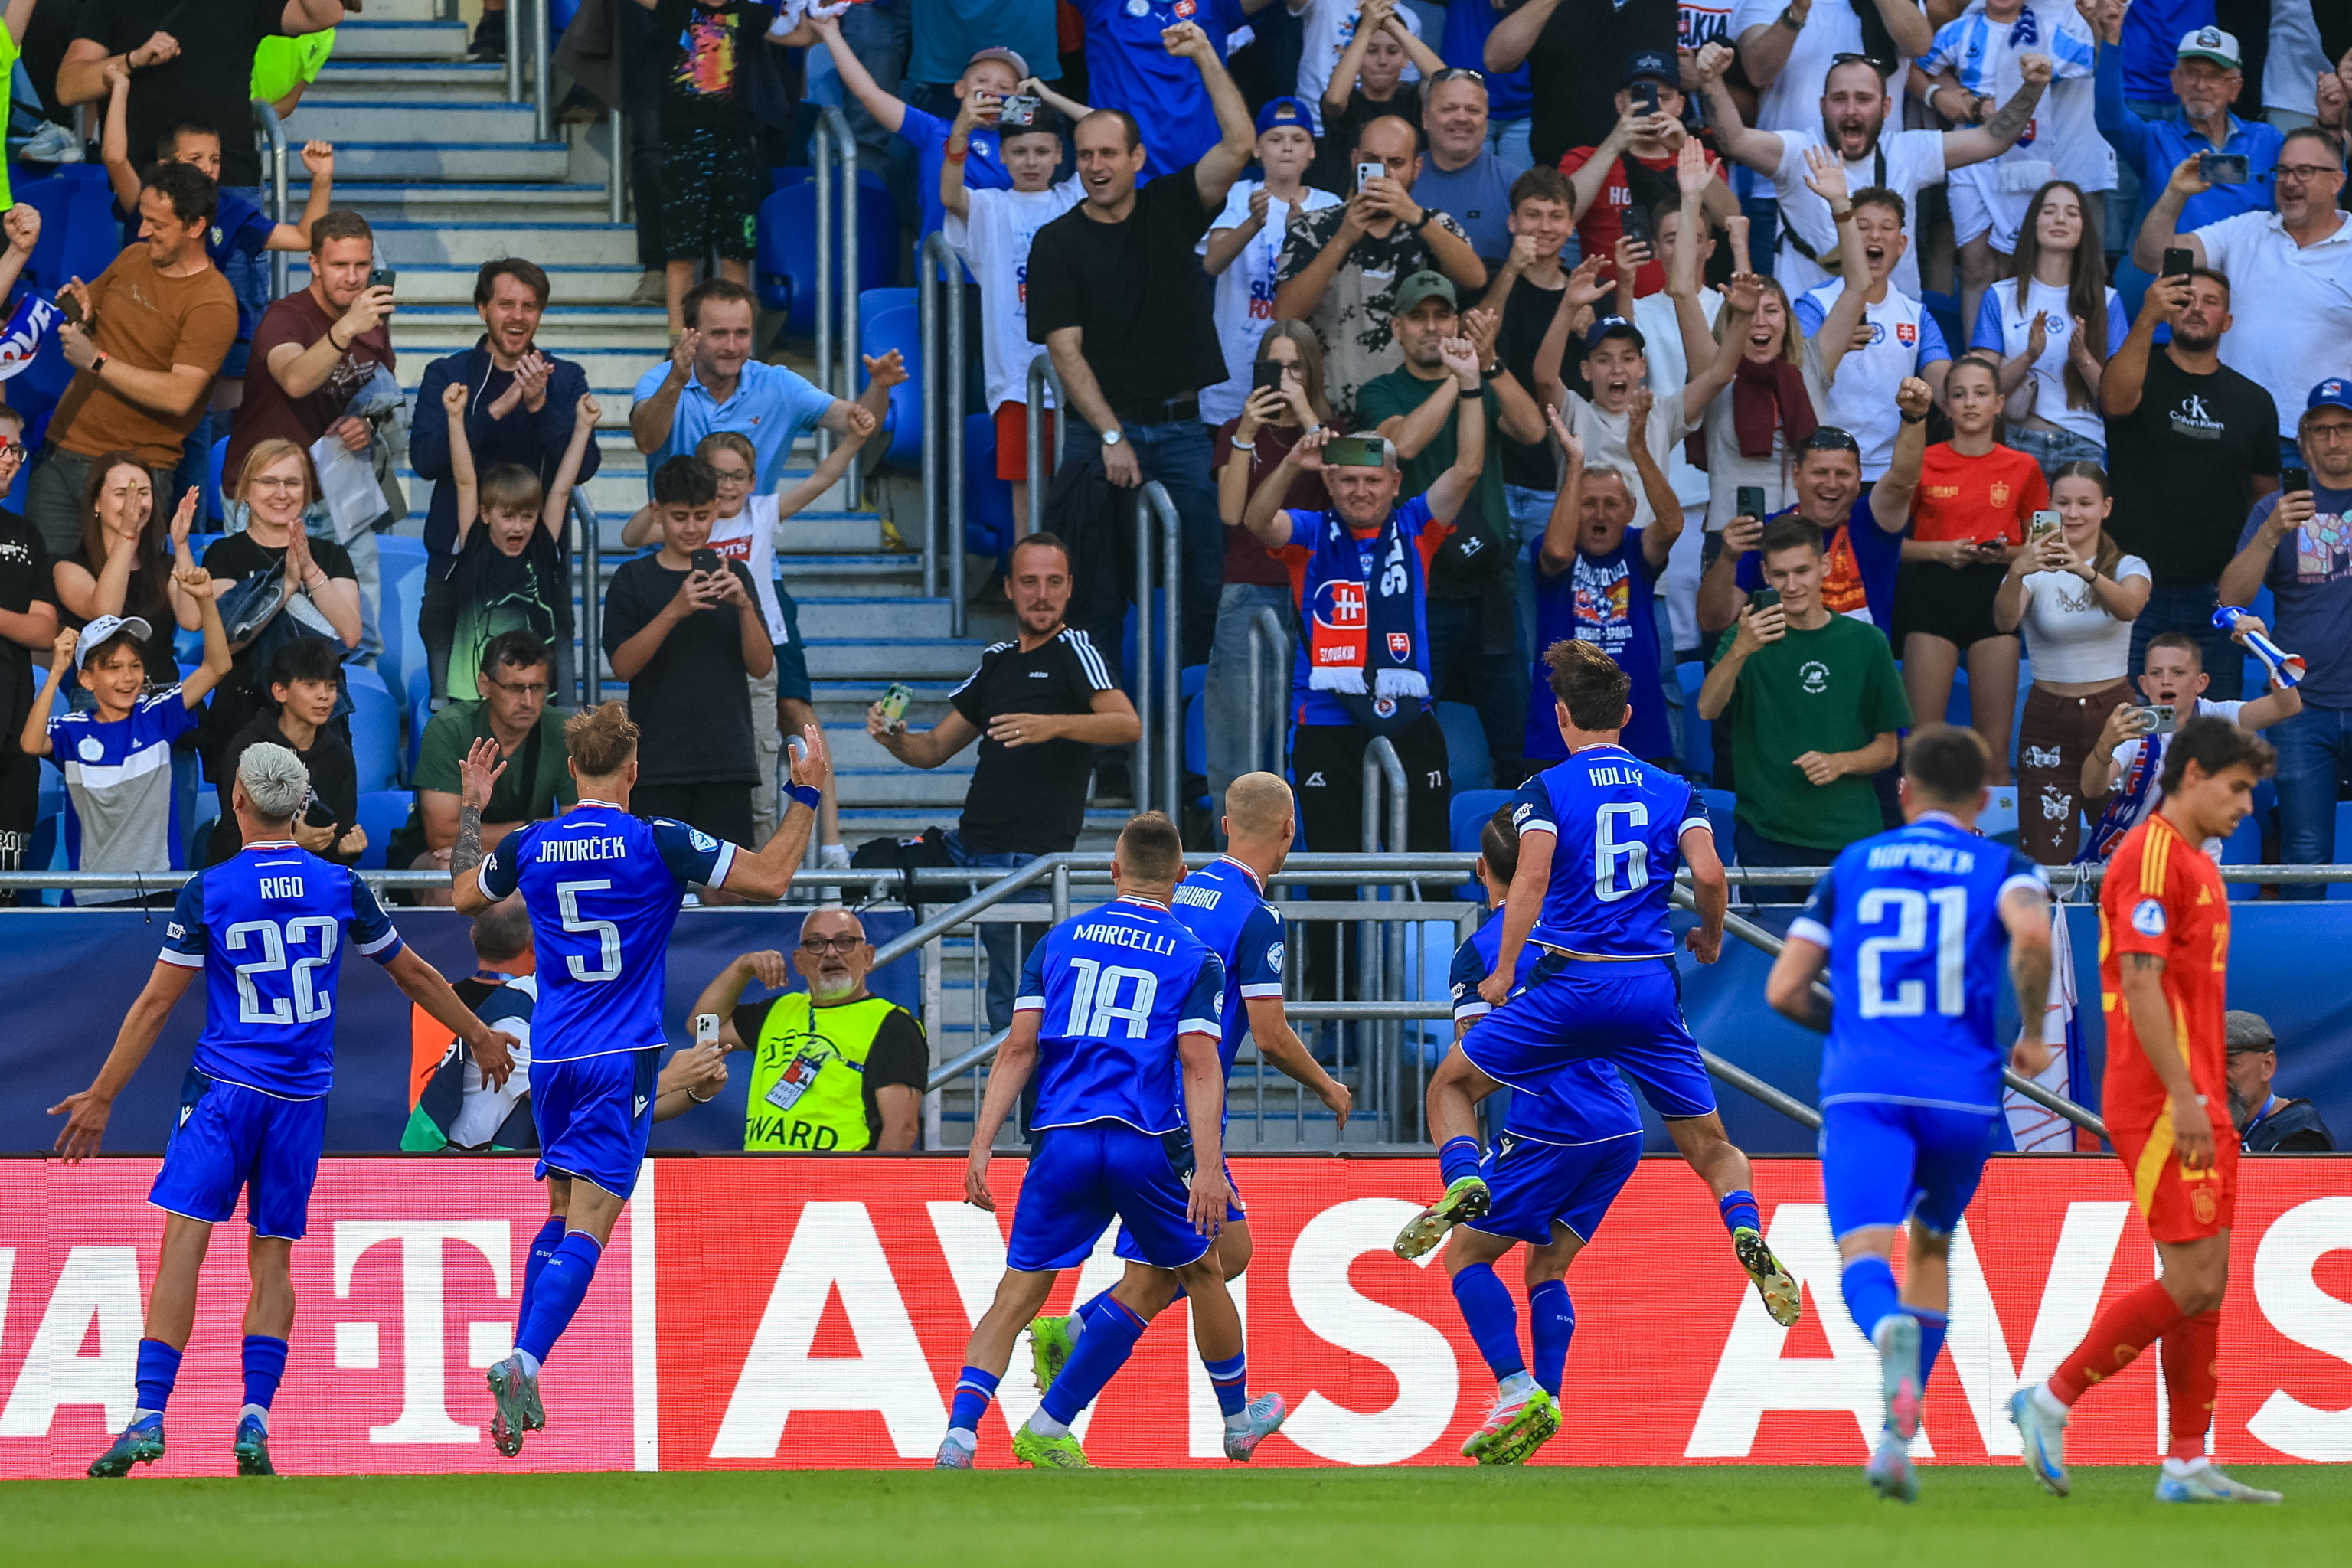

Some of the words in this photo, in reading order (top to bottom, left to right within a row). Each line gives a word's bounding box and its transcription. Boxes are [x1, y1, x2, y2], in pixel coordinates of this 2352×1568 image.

[1319, 645, 1357, 663] SLOVAKIA
[1426, 770, 1442, 789] 77
[1589, 766, 1642, 787] HOLLÝ
[536, 836, 626, 862] JAVORČEK
[1595, 802, 1648, 902] 6
[260, 877, 305, 900] RIGO
[557, 880, 622, 982] 5
[1073, 923, 1177, 956] MARCELLI
[226, 916, 338, 1024] 22
[1857, 886, 1968, 1019] 21
[1062, 957, 1158, 1040] 18
[746, 1115, 838, 1151] WARD
[0, 1246, 146, 1437] A
